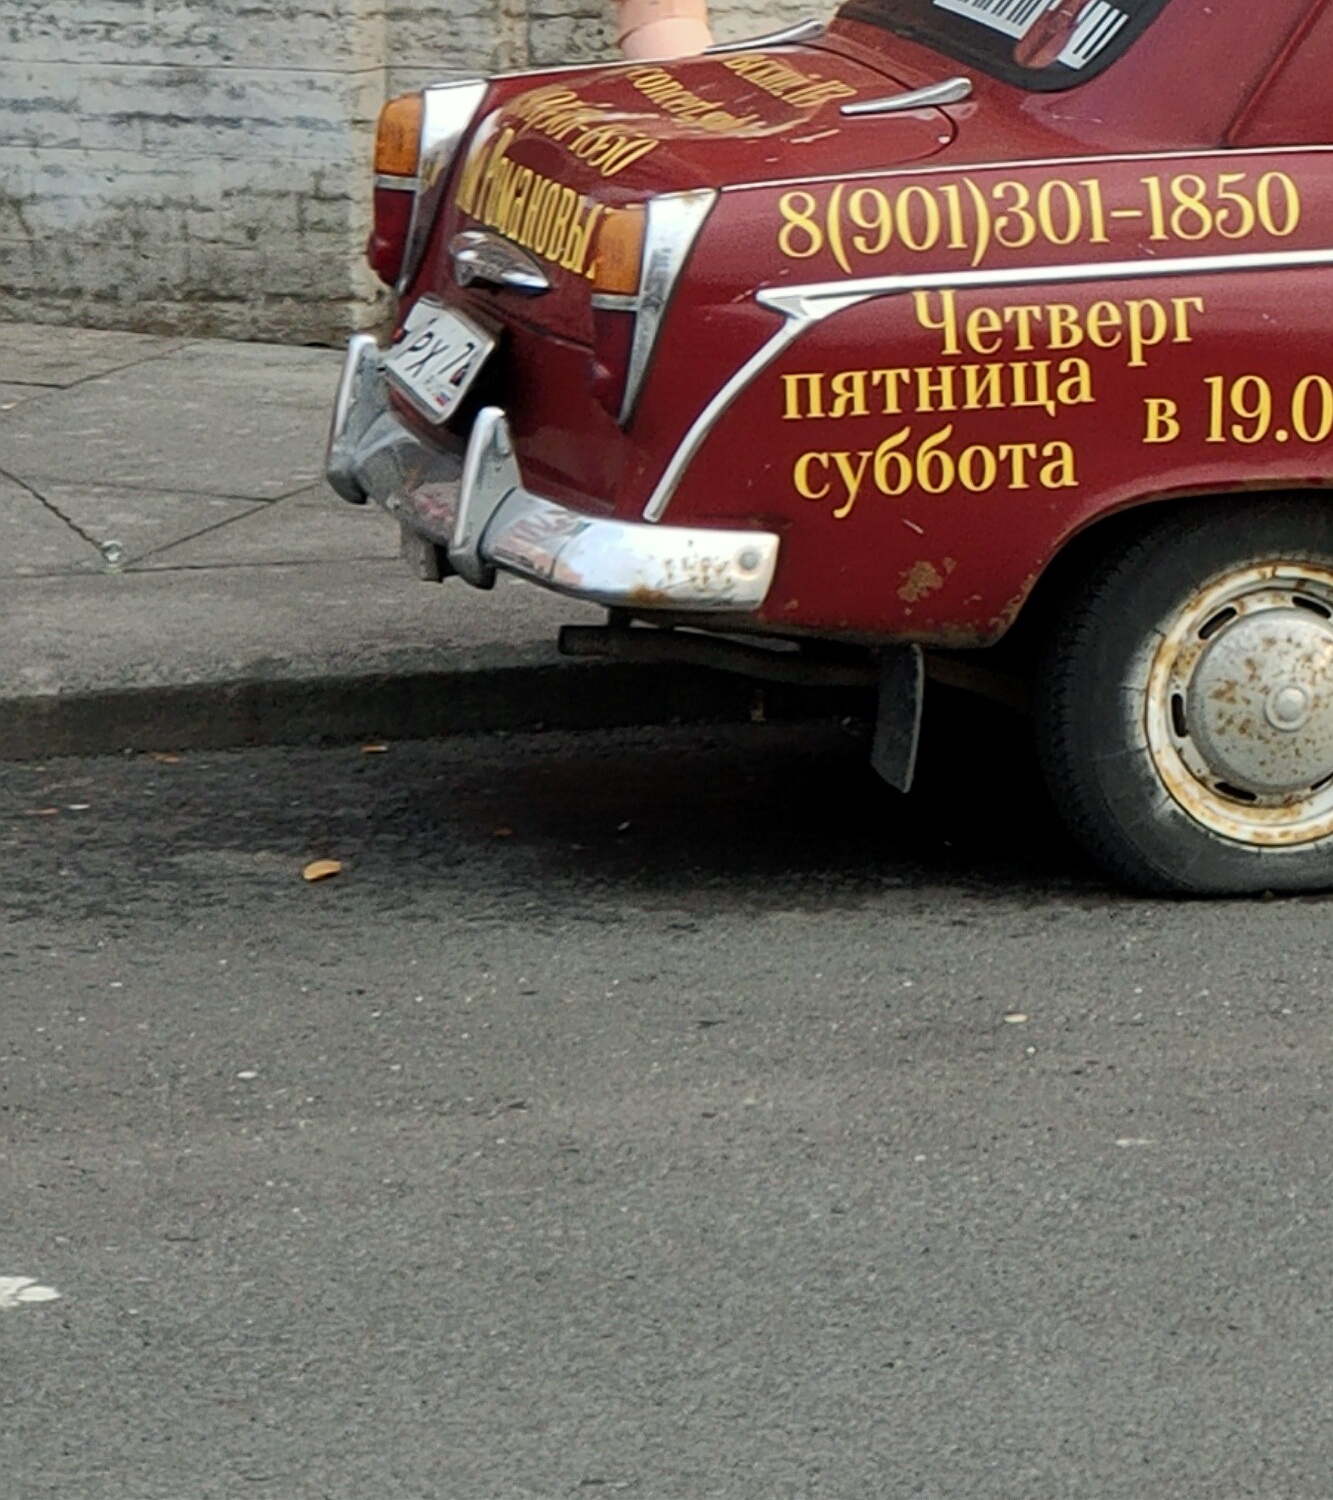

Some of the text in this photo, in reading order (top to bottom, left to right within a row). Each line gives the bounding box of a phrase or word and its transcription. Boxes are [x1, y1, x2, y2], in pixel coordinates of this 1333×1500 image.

[778, 171, 1301, 274] 8(901)301-1850
[913, 289, 1204, 368] Четверг
[781, 356, 1095, 422] пятница
[1143, 397, 1181, 444] в
[793, 424, 1079, 519] суббота
